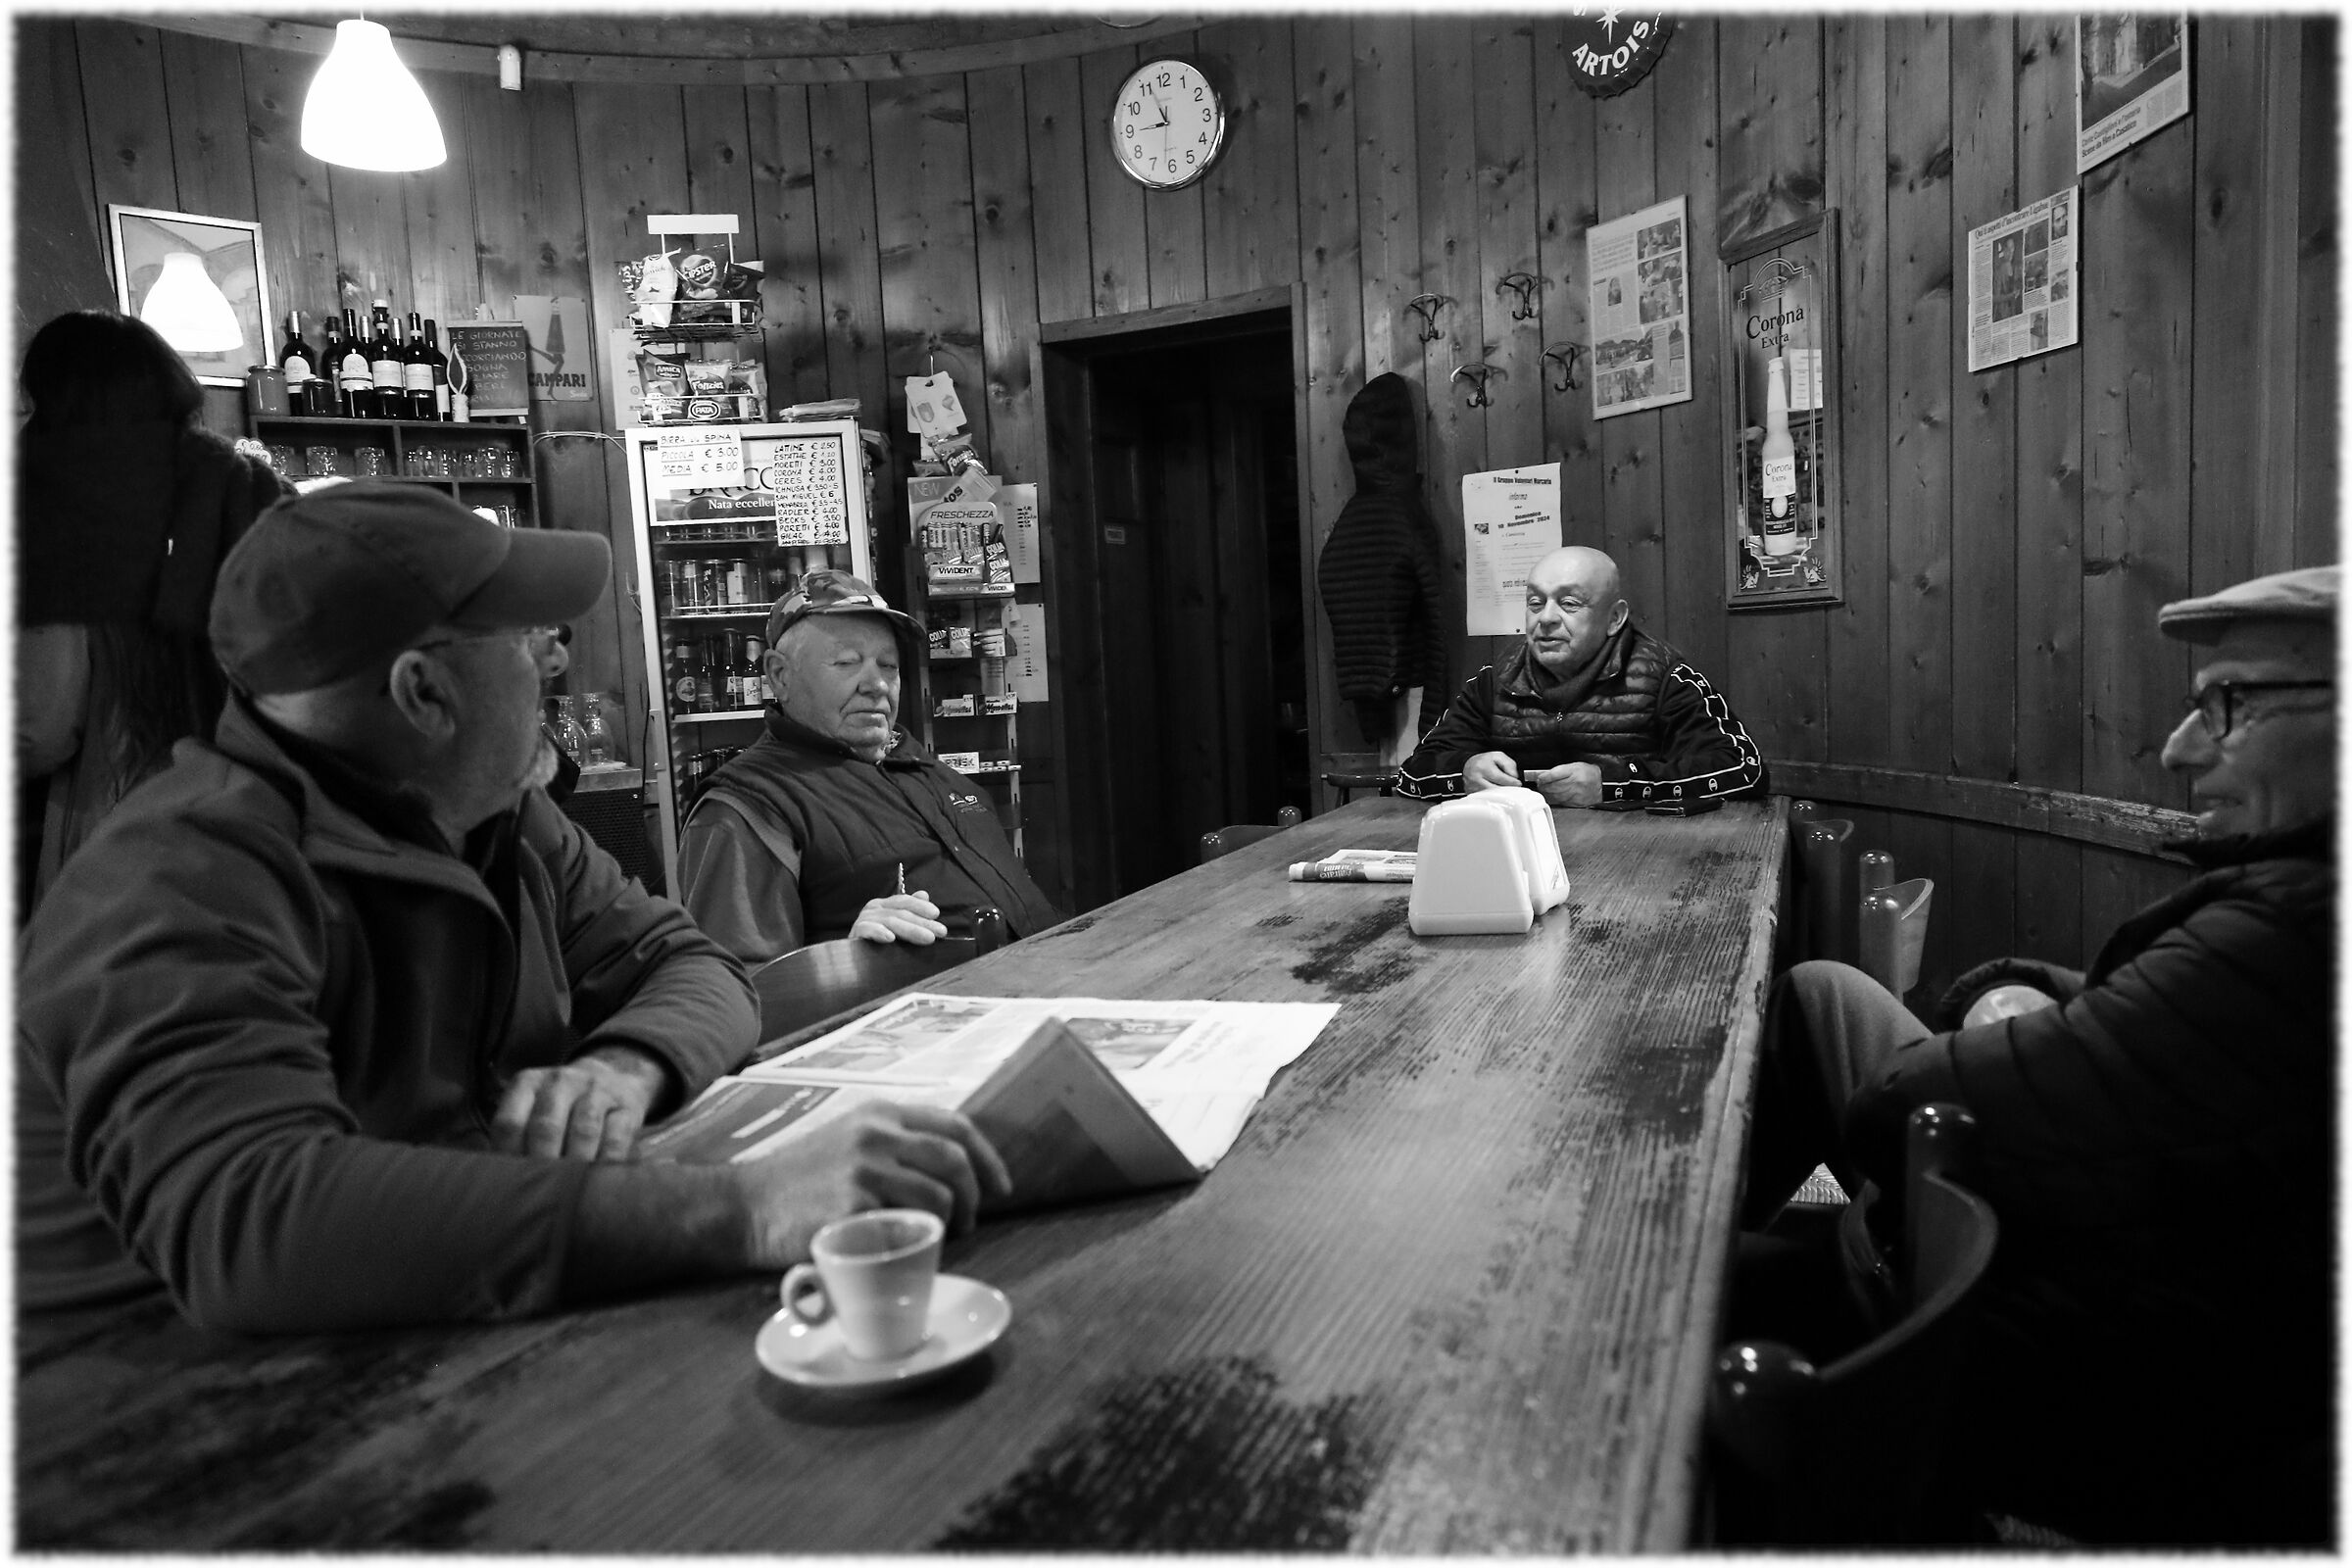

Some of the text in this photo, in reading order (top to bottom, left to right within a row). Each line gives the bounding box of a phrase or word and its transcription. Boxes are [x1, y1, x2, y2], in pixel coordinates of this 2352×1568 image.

[1572, 21, 1649, 76] ARTOIS
[1156, 73, 1171, 87] 12
[1180, 75, 1186, 88] 1
[1140, 81, 1152, 96] 11
[1194, 87, 1203, 102] 2
[1128, 102, 1140, 116] 10
[1202, 108, 1211, 122] 3
[1126, 124, 1134, 138] 9
[1199, 131, 1207, 145] 4
[1134, 145, 1143, 159] 8
[1186, 150, 1195, 164] 5
[1149, 157, 1156, 171] 7
[1168, 159, 1177, 172] 6
[1746, 308, 1804, 339] Corona
[452, 330, 523, 340] LE GIORNATE
[1761, 333, 1789, 349] Extra
[473, 340, 516, 350] STANNO
[528, 373, 587, 388] CAMPARI
[705, 449, 712, 459] €
[701, 464, 710, 472] €
[1765, 463, 1792, 476] Corona
[774, 476, 803, 485] CERES
[914, 482, 940, 497] NEW
[709, 500, 732, 509] Nata
[931, 511, 994, 519] FRESCHEZZA
